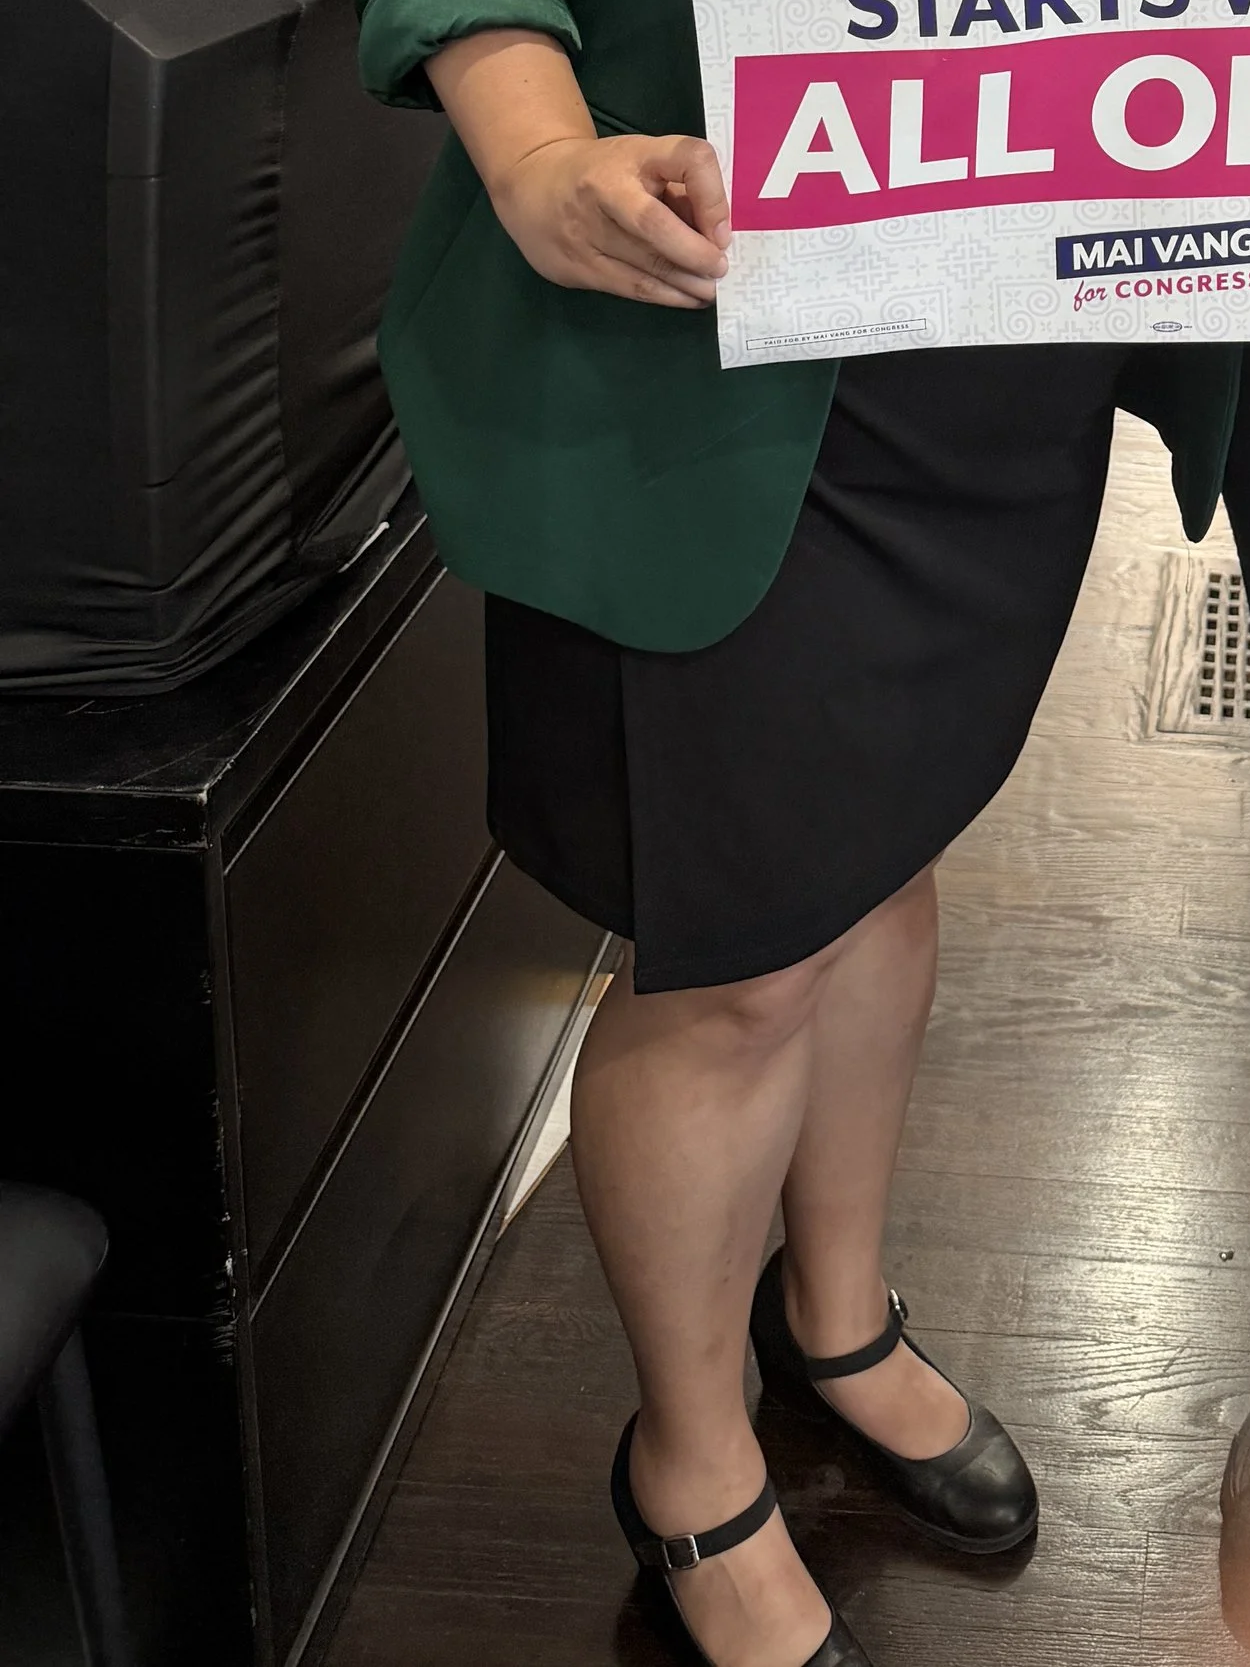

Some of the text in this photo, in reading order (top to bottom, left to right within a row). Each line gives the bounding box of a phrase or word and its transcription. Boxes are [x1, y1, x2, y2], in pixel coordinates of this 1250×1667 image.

[757, 71, 1055, 200] ALL
[1073, 237, 1142, 271] MAI
[1073, 281, 1107, 312] for
[830, 330, 850, 338] VANG
[870, 324, 909, 333] CONGRESS
